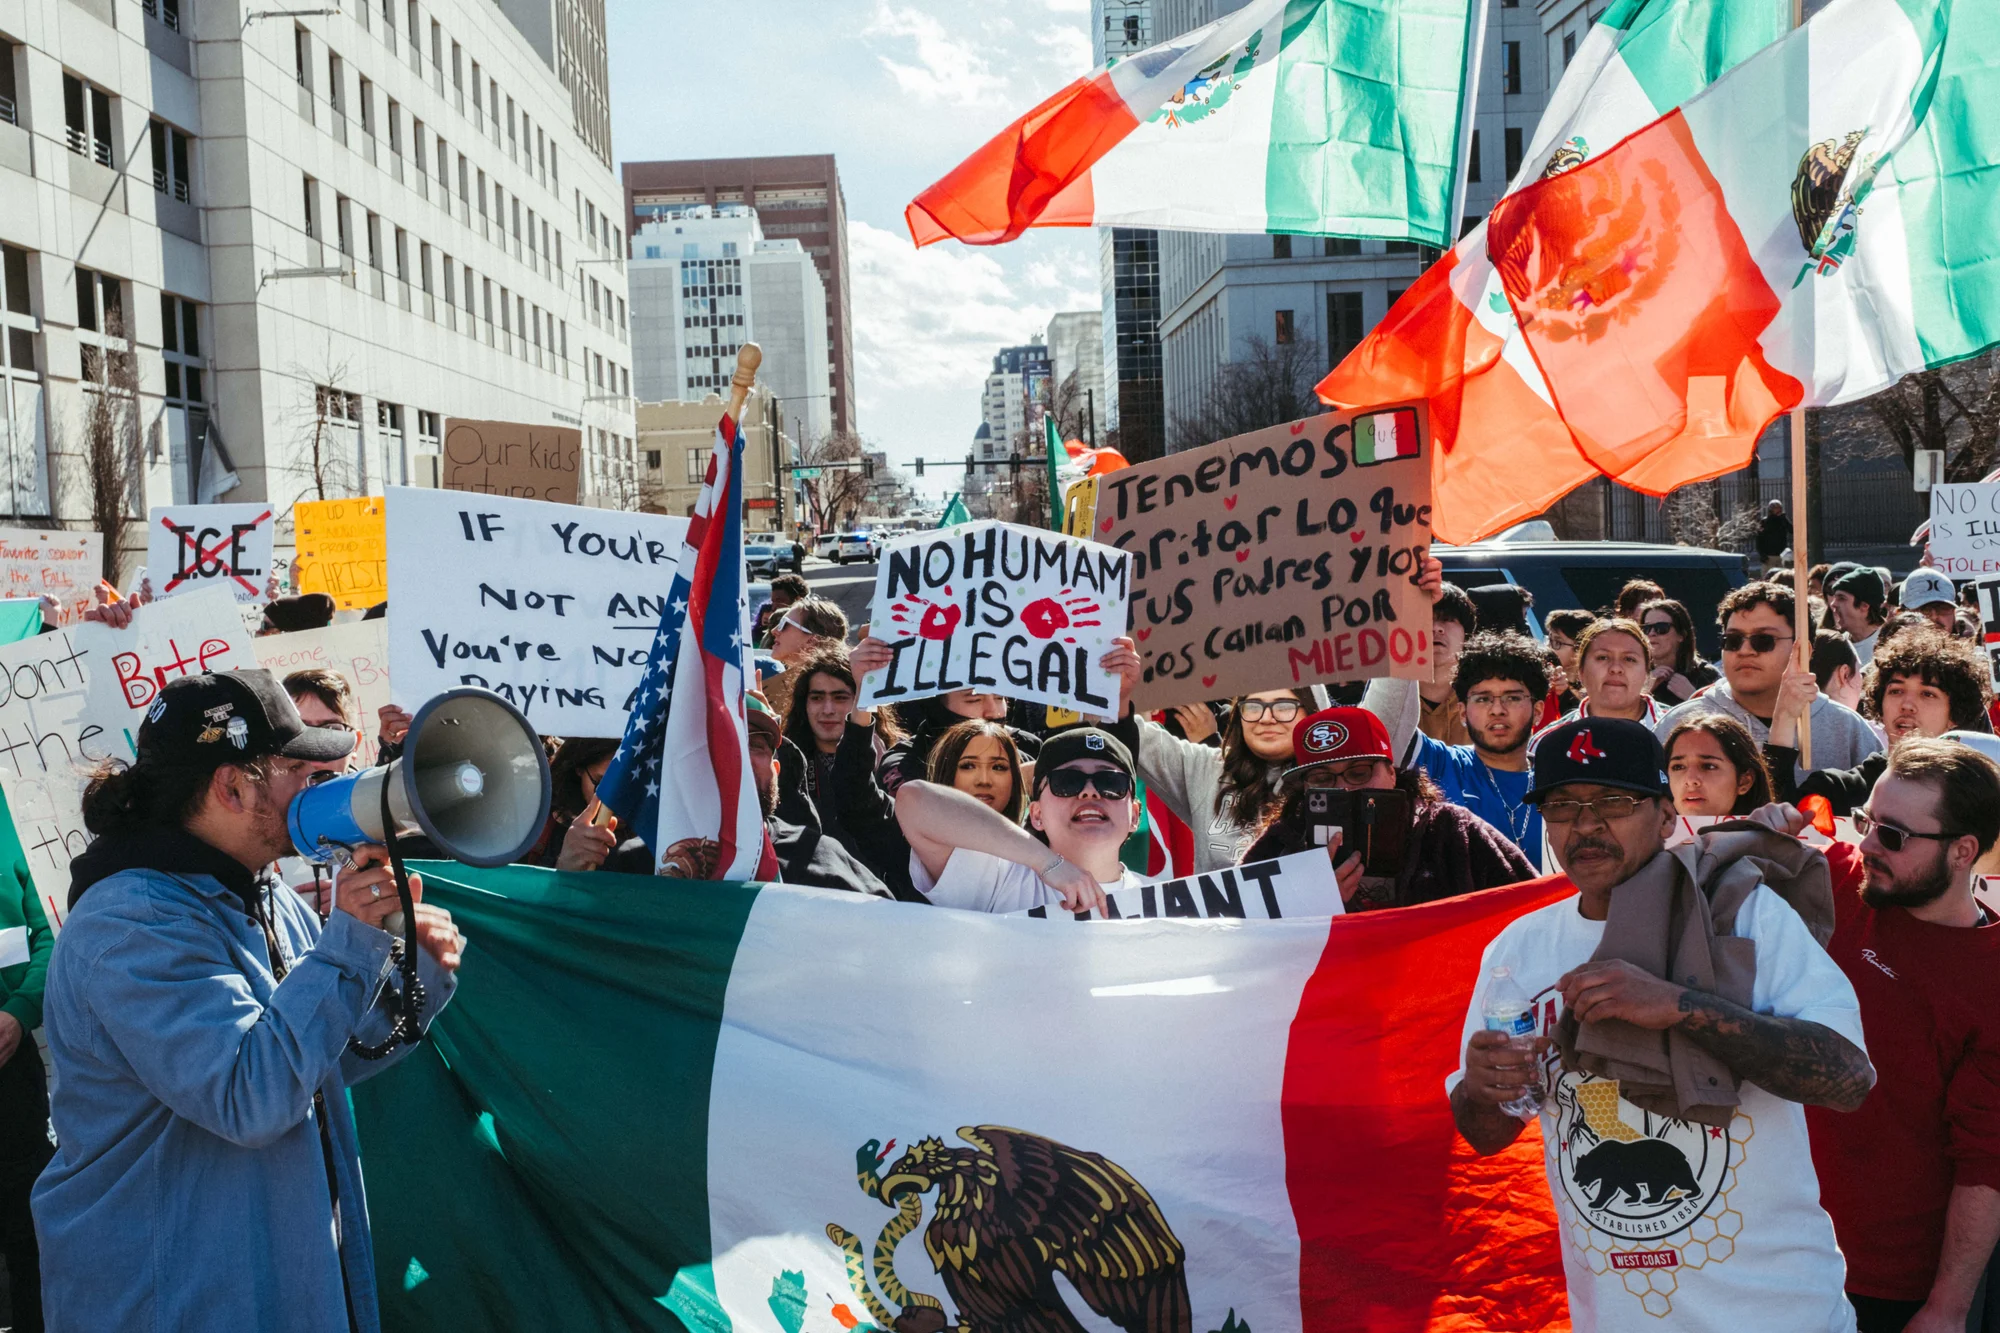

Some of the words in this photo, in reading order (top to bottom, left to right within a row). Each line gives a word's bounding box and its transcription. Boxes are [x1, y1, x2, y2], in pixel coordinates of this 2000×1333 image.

[446, 425, 521, 465] Our
[1936, 489, 1976, 514] NO
[459, 511, 504, 541] IF
[551, 522, 687, 565] YOU'R
[887, 541, 955, 598] NO
[478, 583, 576, 617] NOT
[965, 581, 1014, 628] IS
[421, 629, 561, 669] You're
[592, 645, 651, 668] NO
[1142, 642, 1195, 683] ios
[1322, 588, 1397, 632] POR
[1288, 626, 1428, 682] MIEDO!
[256, 645, 328, 669] meone
[873, 632, 1108, 709] ILLEGAL
[1589, 1210, 1668, 1233] ESTABLISHED
[1671, 1201, 1699, 1223] 1850
[1614, 1255, 1640, 1266] WEST
[1641, 1253, 1672, 1266] COAST
